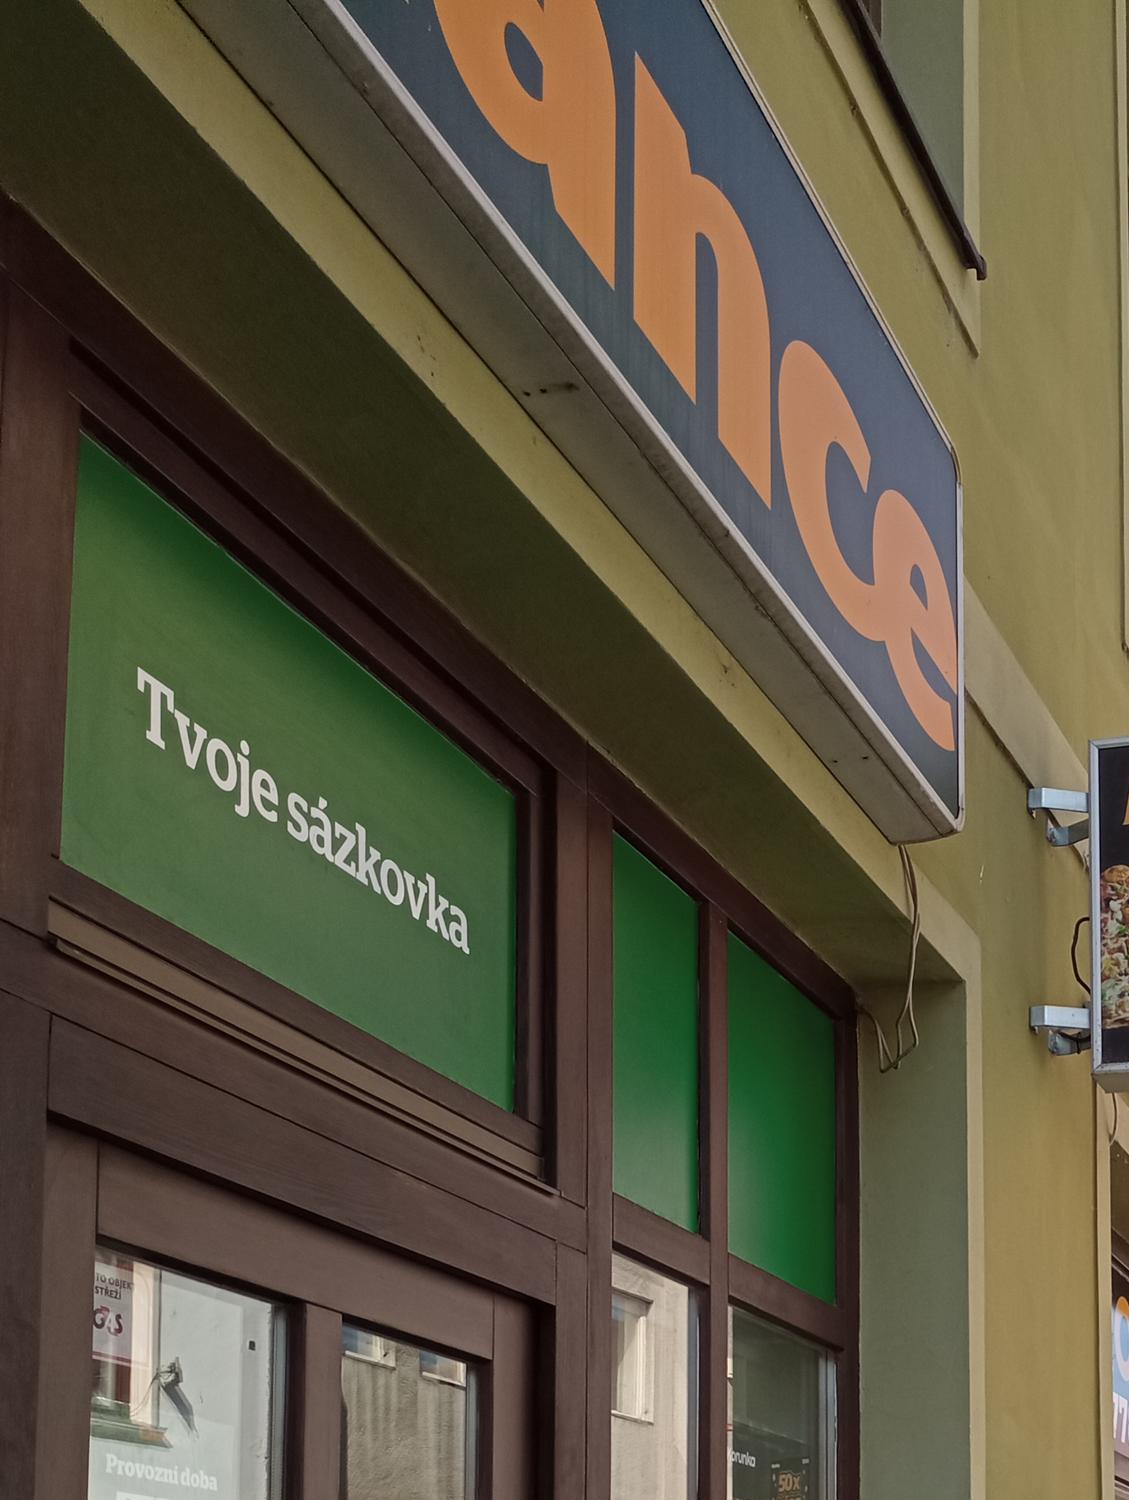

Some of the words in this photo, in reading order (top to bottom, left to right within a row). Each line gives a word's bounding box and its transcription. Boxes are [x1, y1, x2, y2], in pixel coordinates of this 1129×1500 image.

[434, 0, 957, 752] ance
[137, 666, 279, 822] Tvoje
[287, 792, 470, 955] sázkovka
[181, 1467, 218, 1491] doba
